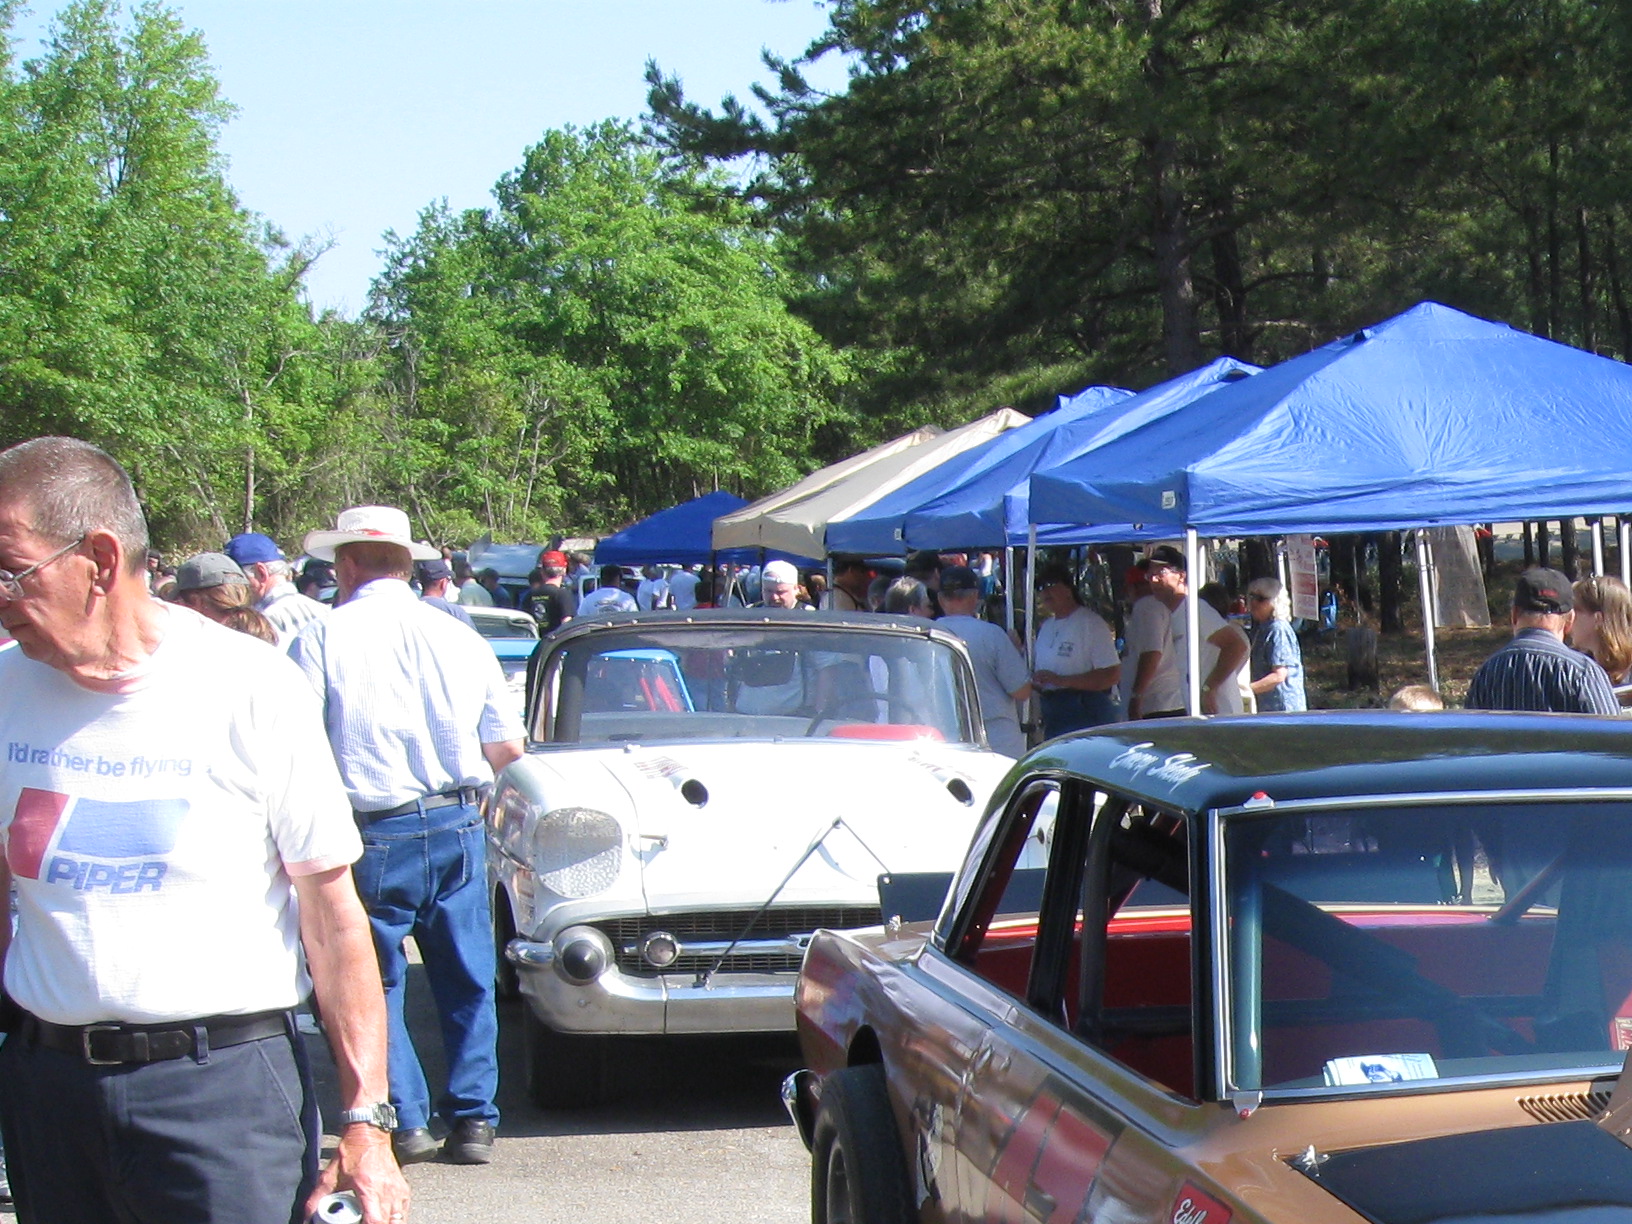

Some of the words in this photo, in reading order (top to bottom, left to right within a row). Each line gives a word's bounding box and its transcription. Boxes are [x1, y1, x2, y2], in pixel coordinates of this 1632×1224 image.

[8, 742, 29, 764] I'd
[31, 747, 94, 773] rather
[96, 755, 126, 777] be
[130, 756, 192, 779] flying
[47, 855, 168, 895] PIPER
